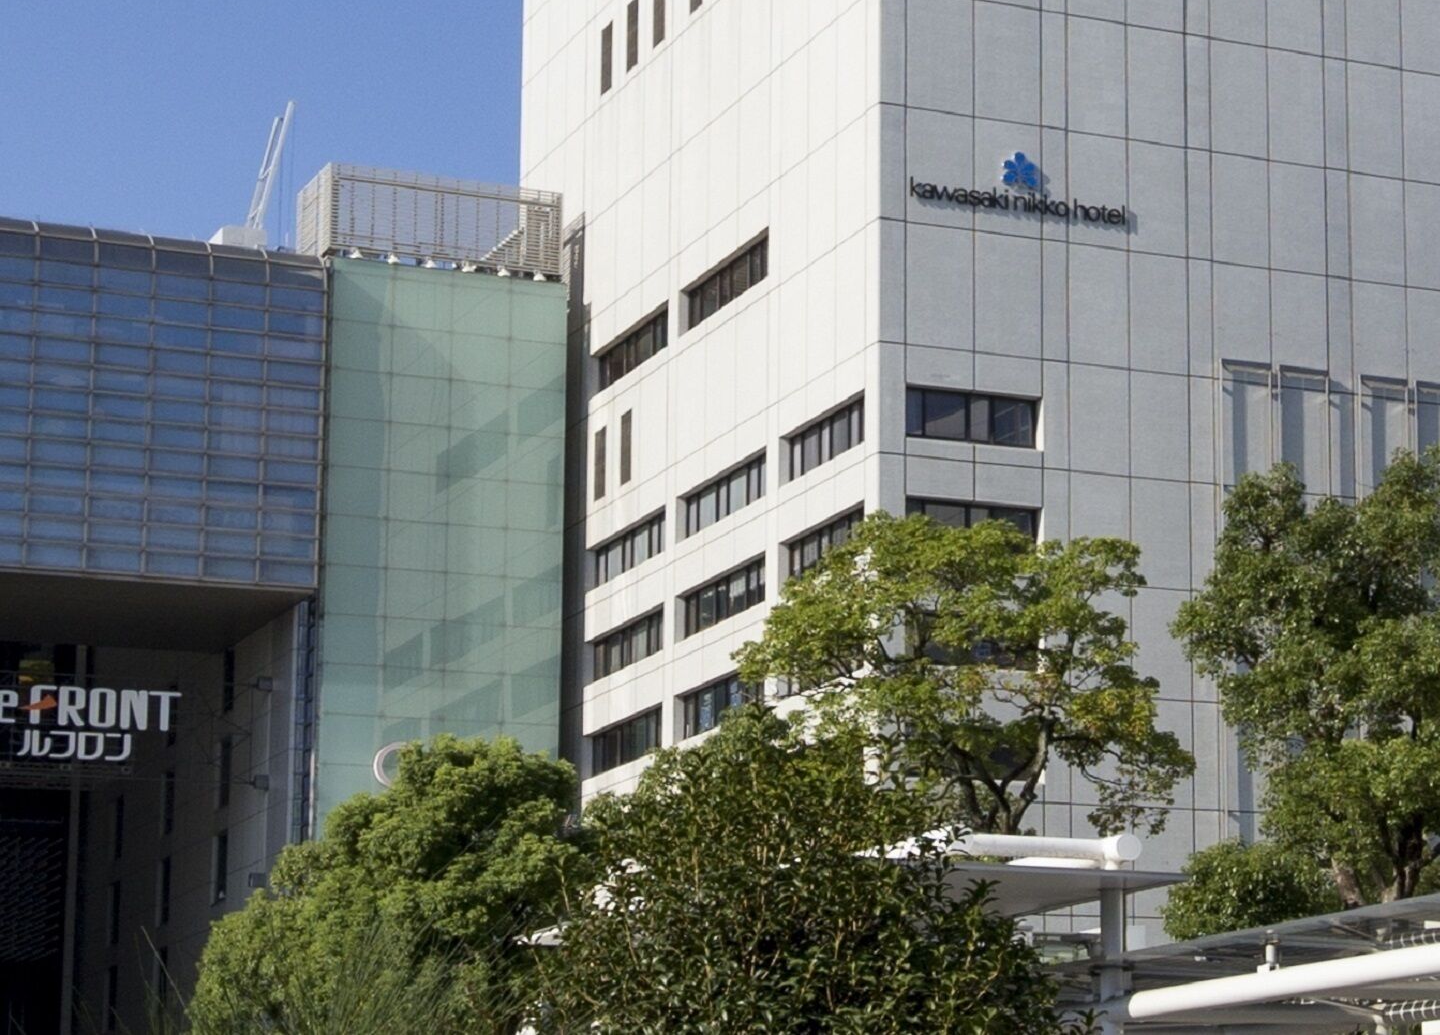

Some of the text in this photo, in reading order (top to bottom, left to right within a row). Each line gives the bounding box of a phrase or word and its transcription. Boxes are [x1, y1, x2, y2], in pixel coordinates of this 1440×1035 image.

[910, 176, 1127, 226] kawasaki nikko hotel
[24, 684, 183, 732] FRONT
[16, 729, 132, 762] ルフロン
